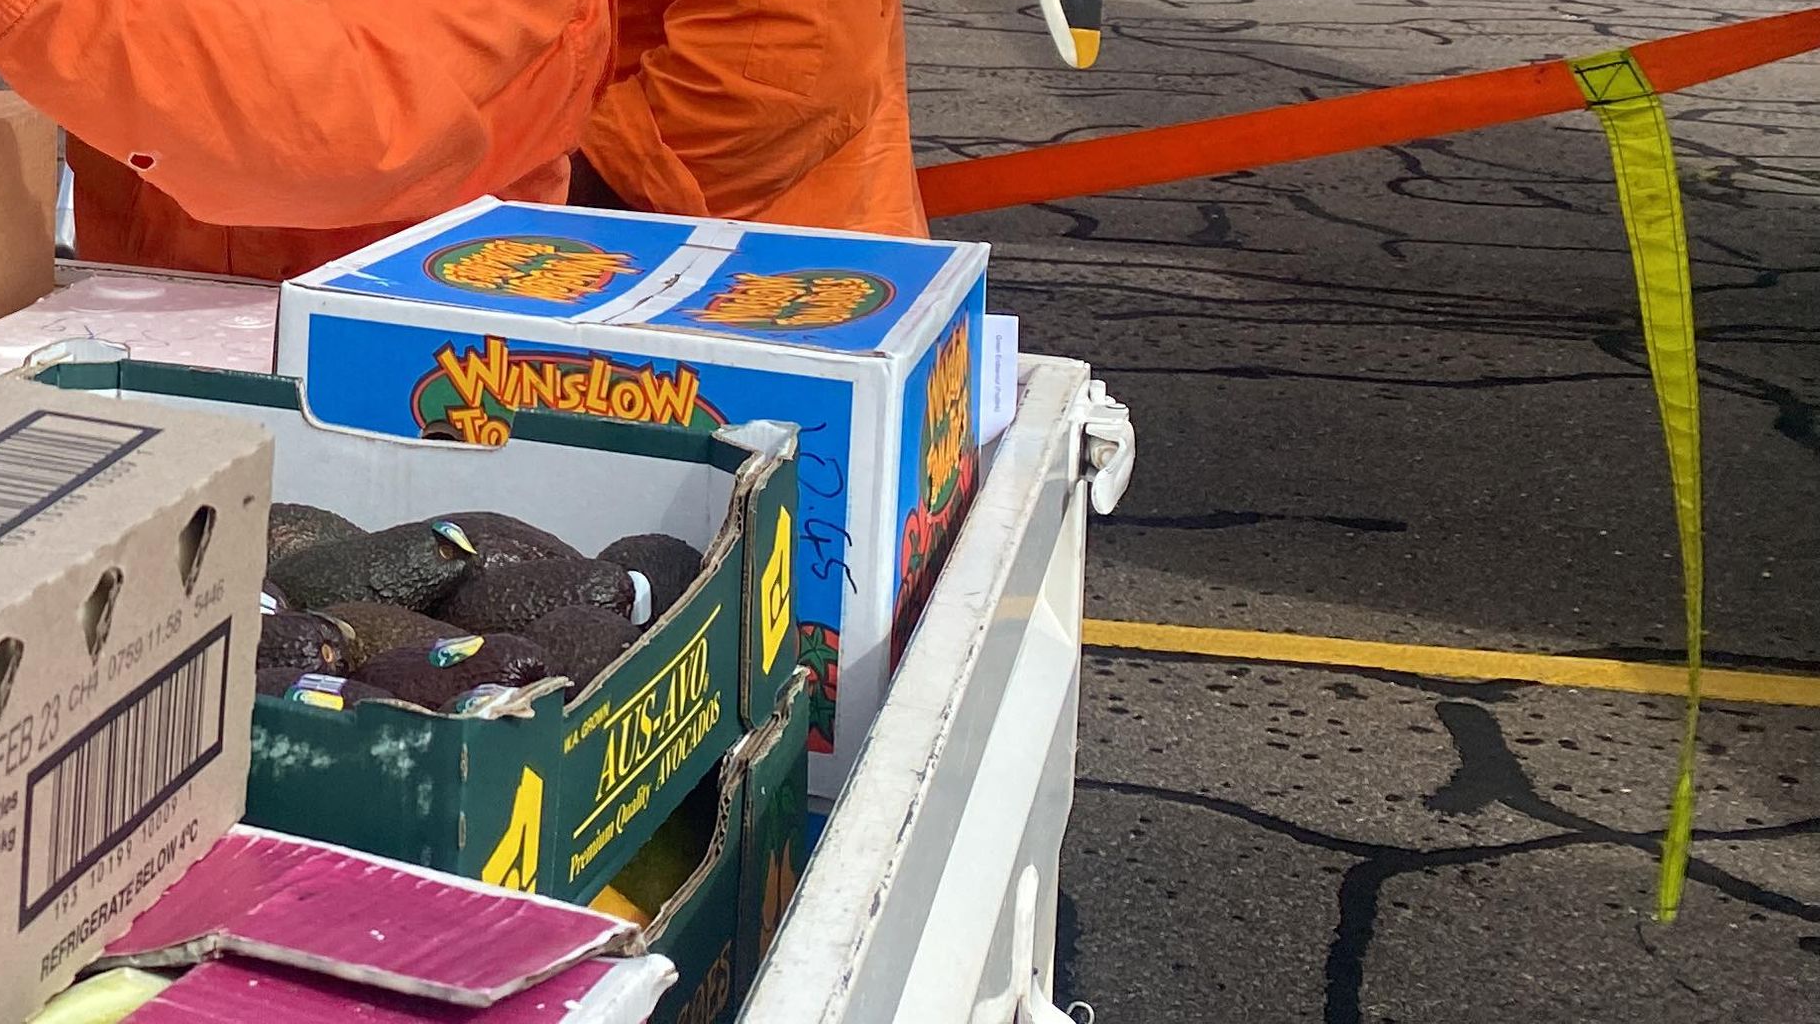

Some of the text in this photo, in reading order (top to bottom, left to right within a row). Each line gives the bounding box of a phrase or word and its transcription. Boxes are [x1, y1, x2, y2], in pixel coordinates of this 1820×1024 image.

[432, 335, 700, 428] WINSLOW
[38, 694, 61, 753] 23
[193, 578, 226, 619] 5446
[580, 700, 611, 740] GROWN
[595, 637, 708, 803] AUS-AVO
[655, 691, 721, 792] AVOCADOS
[568, 782, 652, 884] Premium Quality
[40, 885, 134, 982] REFRIGERATE
[134, 845, 178, 896] BELOW
